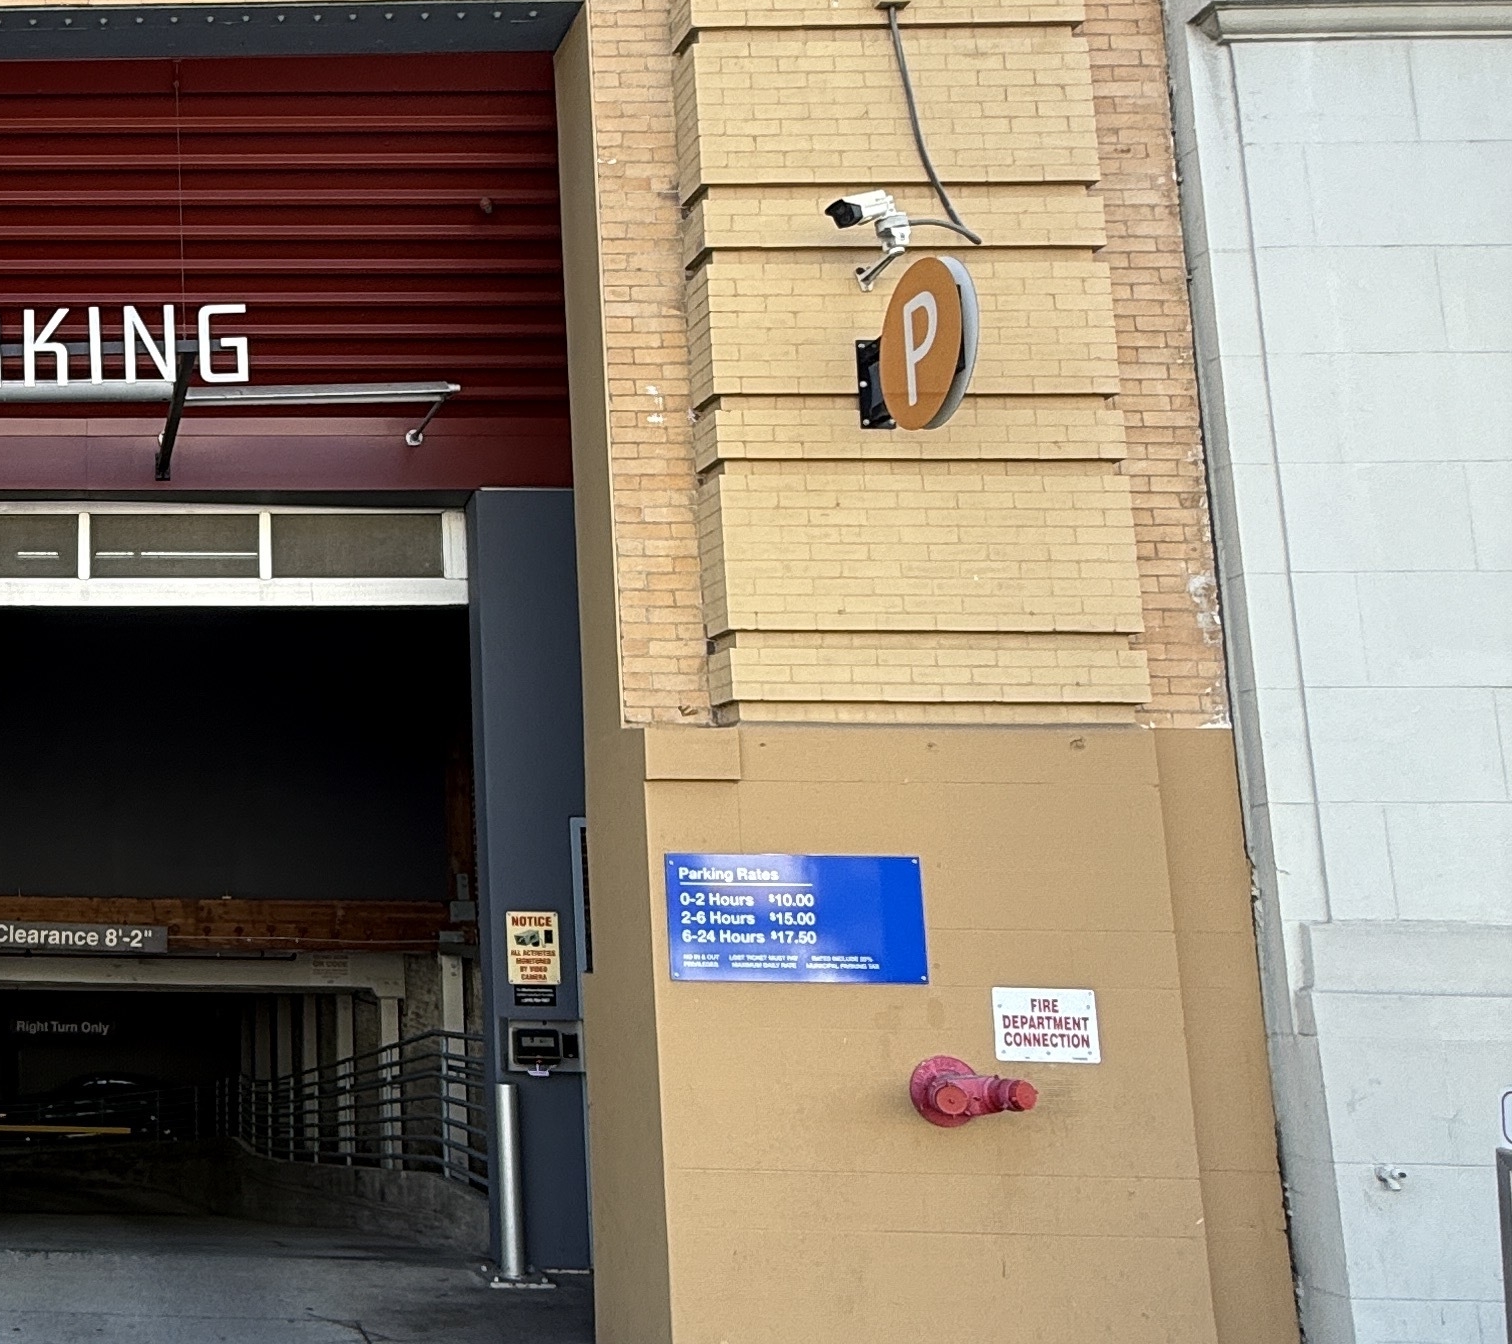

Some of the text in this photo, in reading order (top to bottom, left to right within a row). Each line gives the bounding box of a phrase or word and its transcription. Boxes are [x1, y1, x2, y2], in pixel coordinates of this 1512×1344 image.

[903, 291, 937, 406] P
[678, 866, 780, 883] Parking Rates
[679, 892, 815, 908] 0-2 Hours $10.00
[511, 916, 553, 927] NOTICE
[680, 910, 816, 926] 2-6 Hours $15.00
[104, 927, 152, 948] 8'-2"
[681, 928, 817, 944] 6-24 Hours $17.50
[1030, 998, 1059, 1013] FIRE
[16, 1020, 110, 1036] Right Turn Only
[1002, 1014, 1090, 1031] DEPARTMENT
[1003, 1032, 1091, 1048] CONNECTION
